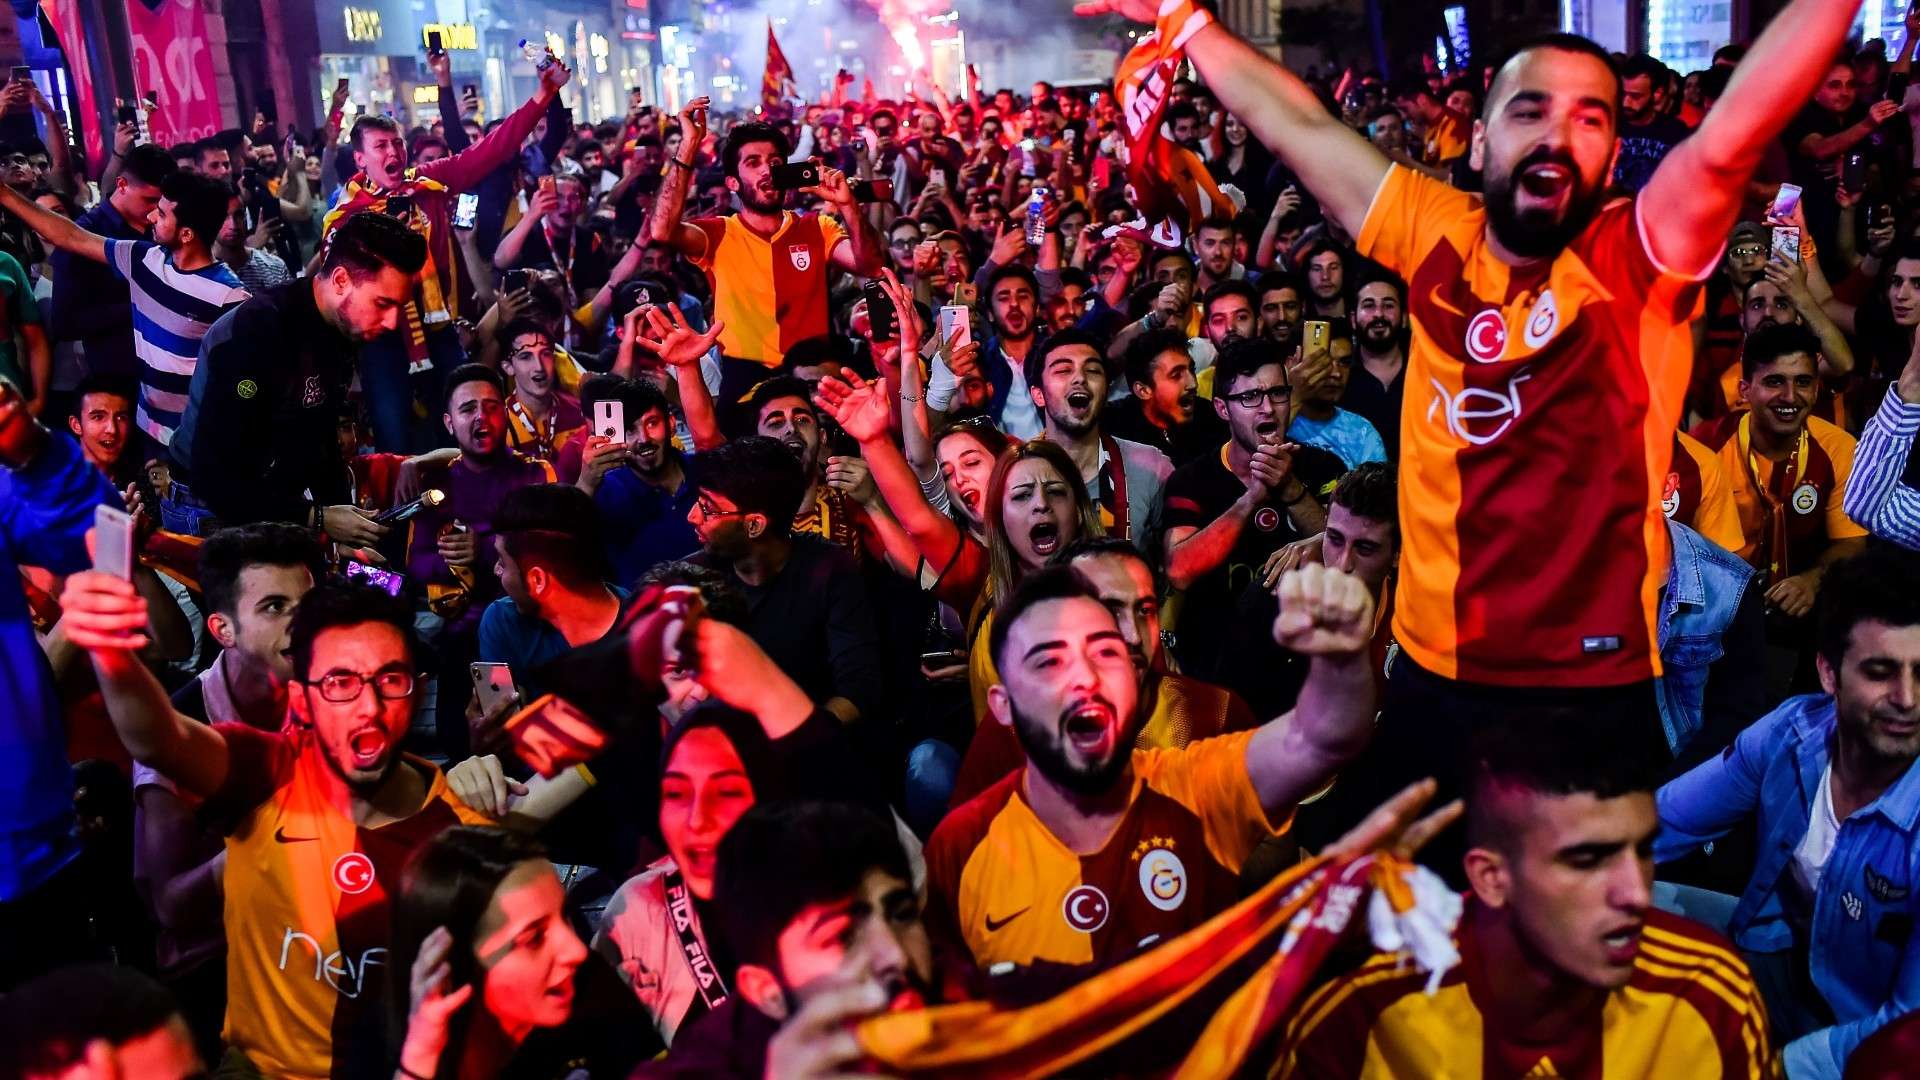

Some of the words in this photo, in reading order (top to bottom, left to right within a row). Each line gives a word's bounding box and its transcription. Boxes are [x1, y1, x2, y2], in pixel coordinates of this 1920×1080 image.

[667, 885, 690, 933] FILA
[279, 926, 389, 999] nef
[684, 941, 715, 989] FILA
